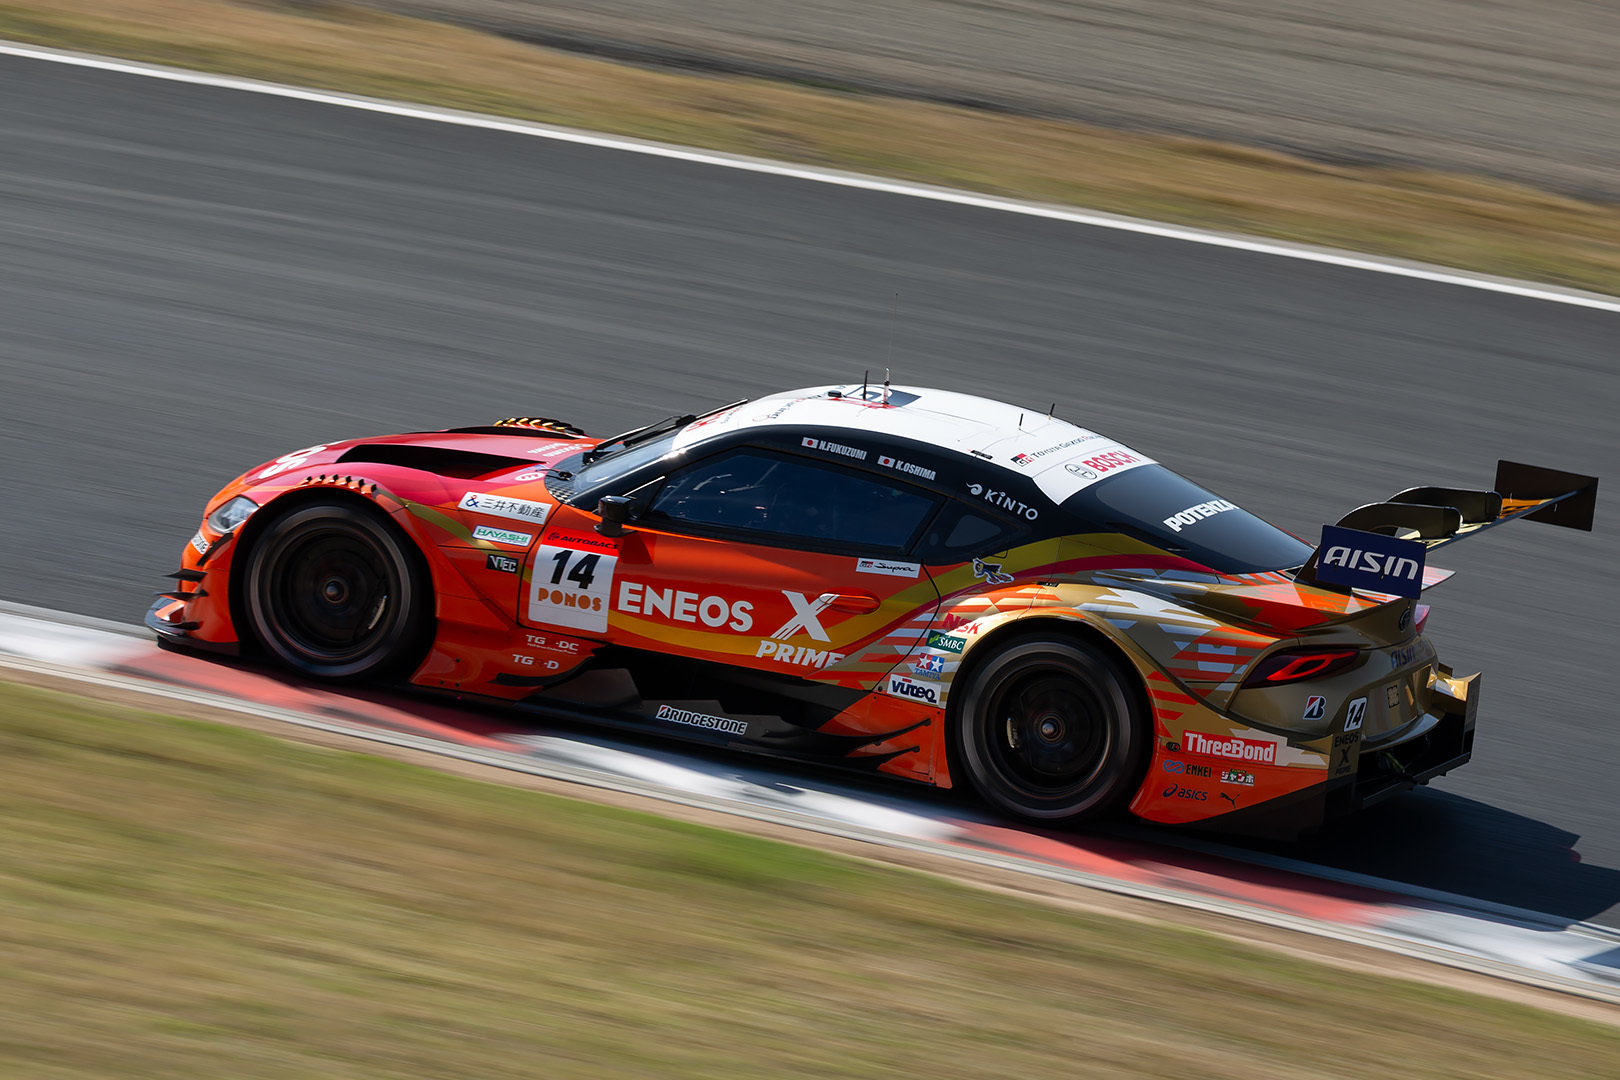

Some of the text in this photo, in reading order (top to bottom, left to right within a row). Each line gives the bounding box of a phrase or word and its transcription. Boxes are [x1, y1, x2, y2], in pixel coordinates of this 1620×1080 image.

[818, 440, 867, 461] N.FUKUZUMI
[1082, 450, 1141, 472] BOSCH
[895, 460, 936, 481] K.OSHIMA
[481, 498, 544, 518] 三井不動産
[984, 488, 1039, 521] KINTO
[1163, 499, 1240, 533] POTENZA
[476, 528, 528, 543] HAYASHI
[560, 535, 620, 549] AUTOBACS
[550, 549, 601, 589] 14
[874, 562, 916, 573] Supra
[1323, 546, 1419, 580] AISIN
[538, 587, 602, 612] PONOS
[617, 580, 754, 632] ENEOS
[769, 589, 840, 643] X
[941, 612, 984, 635] NSK
[938, 636, 964, 651] SMBC
[914, 667, 941, 681] TAMIYA
[656, 705, 747, 735] BRIDGESTONE
[1346, 702, 1366, 731] 14
[1185, 732, 1275, 762] ThreeBond
[1334, 731, 1359, 748] ENEOS
[1186, 764, 1212, 778] ENKEI
[1177, 788, 1208, 801] asics
